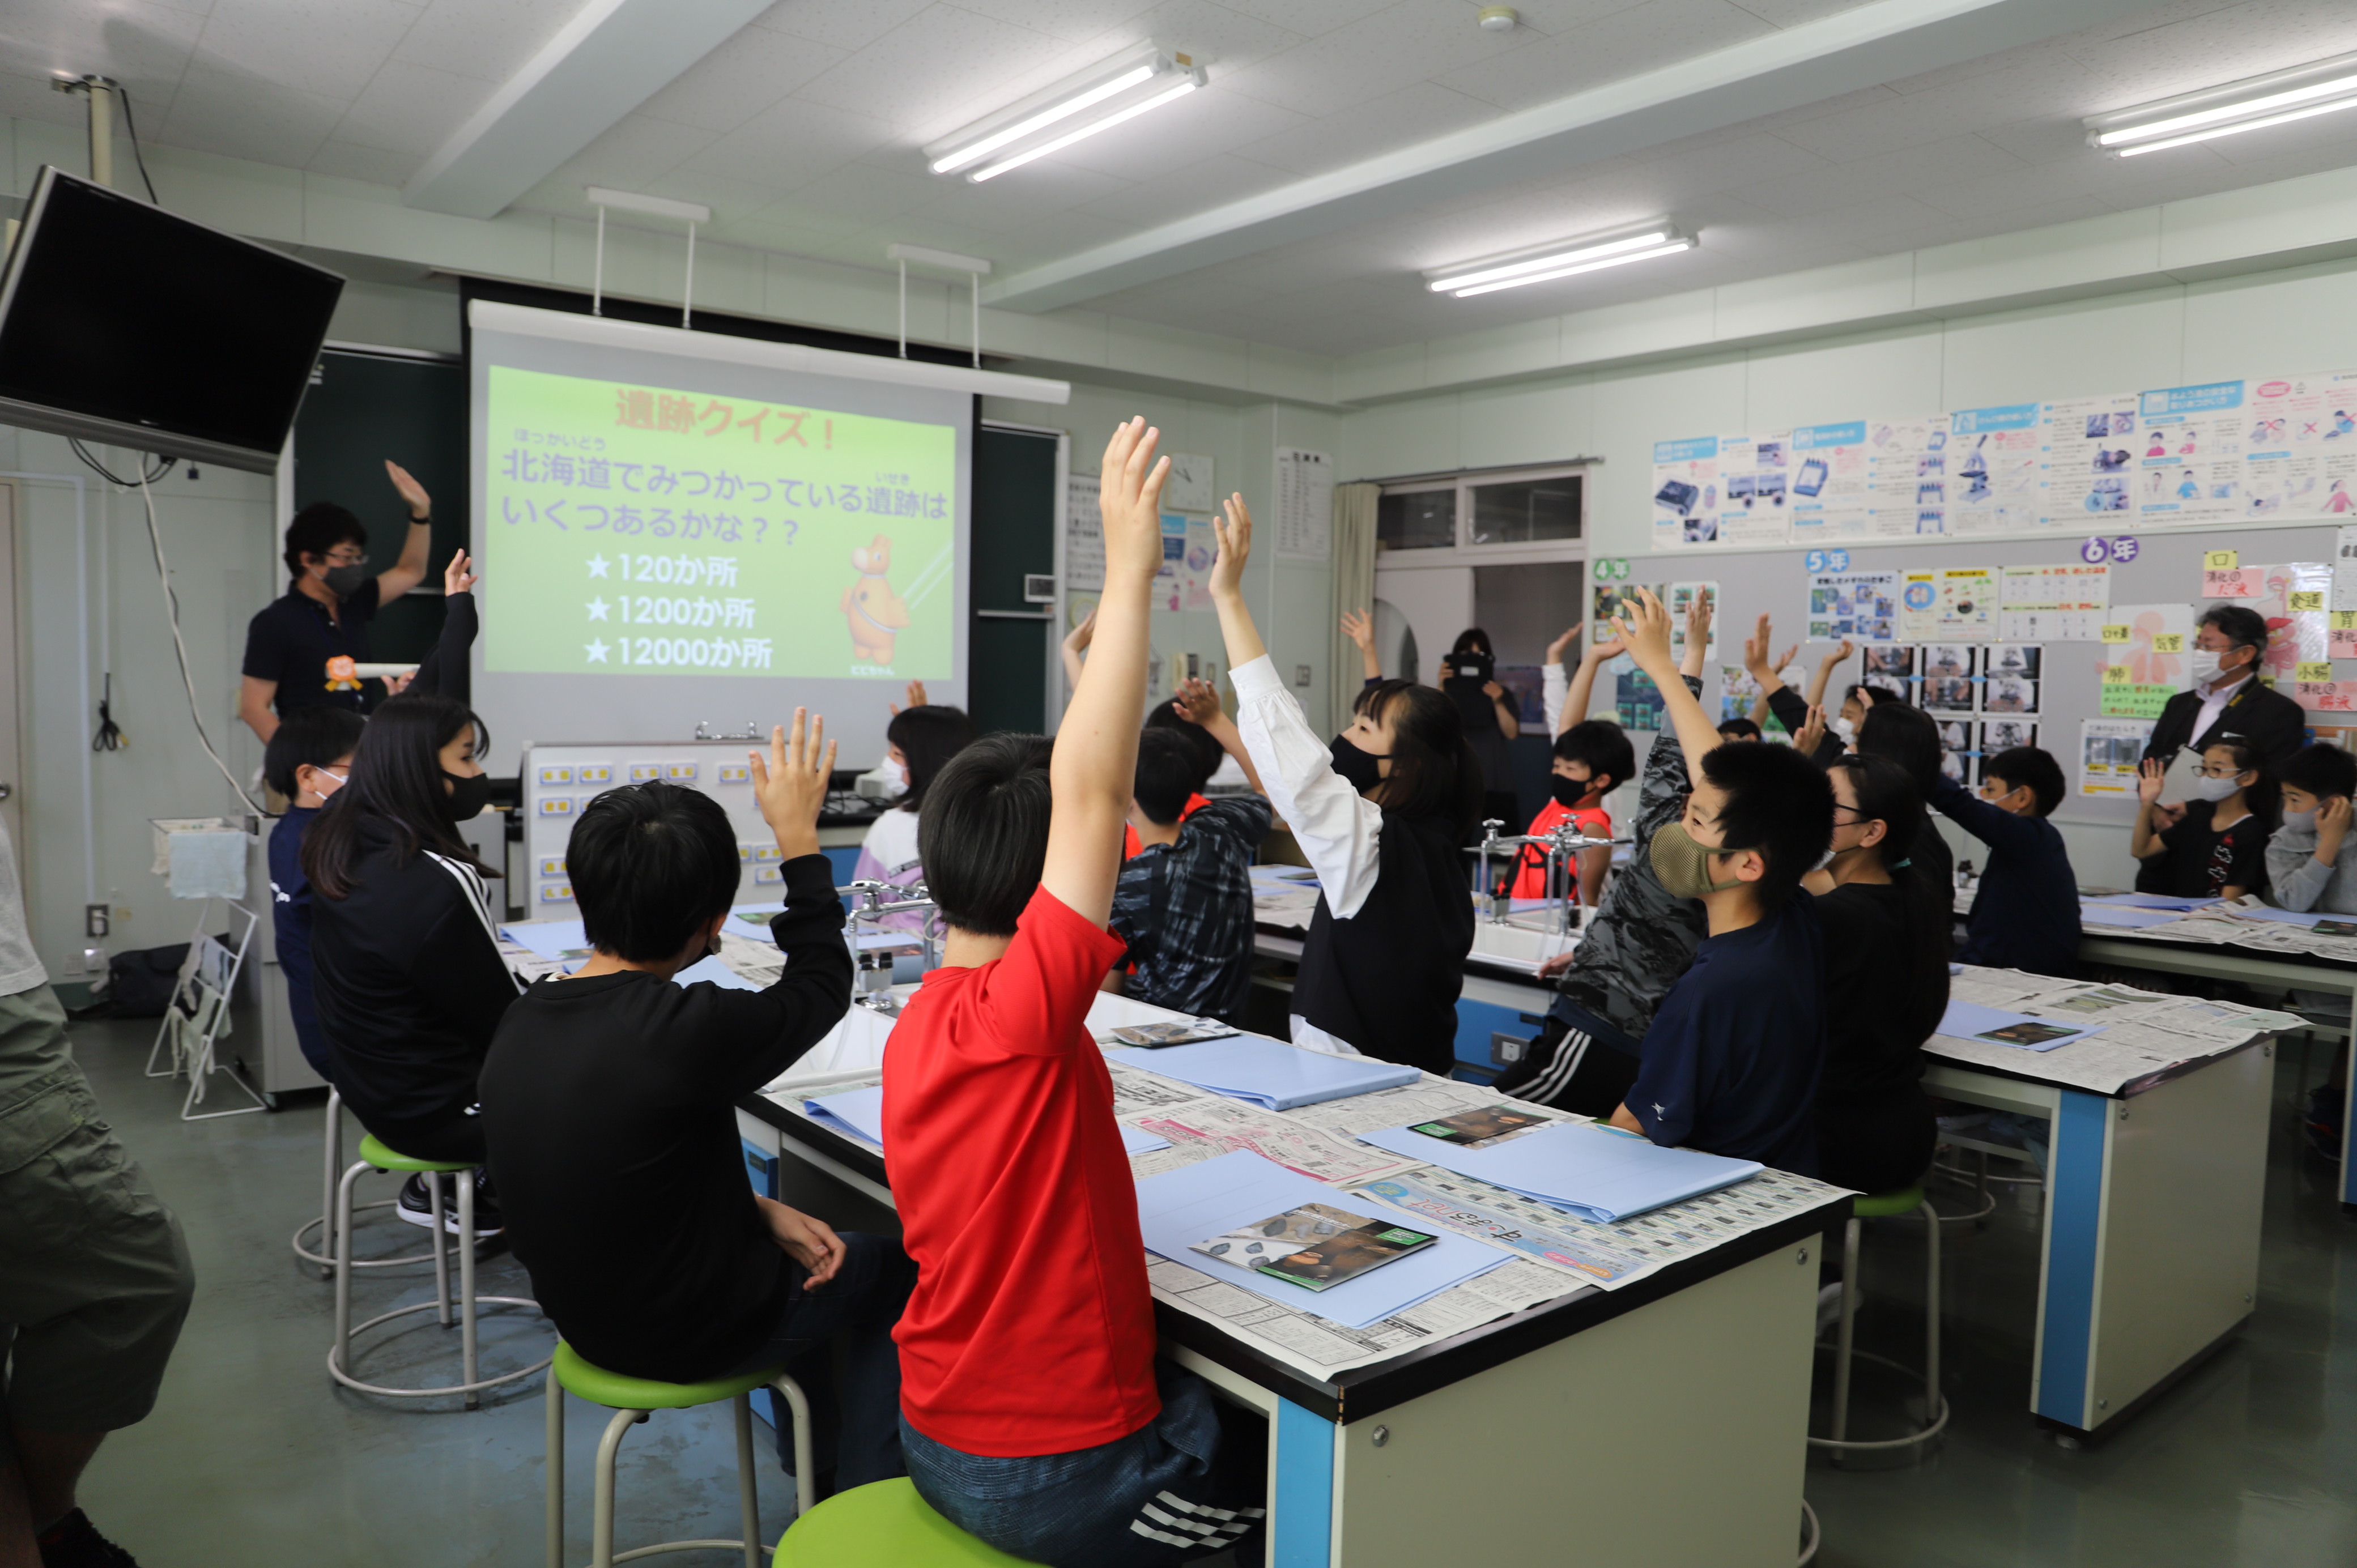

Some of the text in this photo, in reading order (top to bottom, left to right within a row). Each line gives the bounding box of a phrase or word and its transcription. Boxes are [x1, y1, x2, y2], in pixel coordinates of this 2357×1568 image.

[615, 388, 835, 450] 遺跡クイズ！
[514, 428, 606, 451] ほっかいどう
[501, 448, 948, 521] 北海道でみつかっている遺跡は
[875, 471, 911, 487] いせき
[502, 496, 800, 546] いくつあるかな？？
[2085, 538, 2137, 560] 6年
[617, 553, 739, 588] 120か所
[1596, 560, 1629, 578] 4年
[1809, 551, 1849, 571] 5年
[617, 595, 756, 629] 1200か所
[2290, 593, 2321, 610] 食道
[617, 636, 774, 670] 12000か所
[2298, 664, 2329, 681] 小腸
